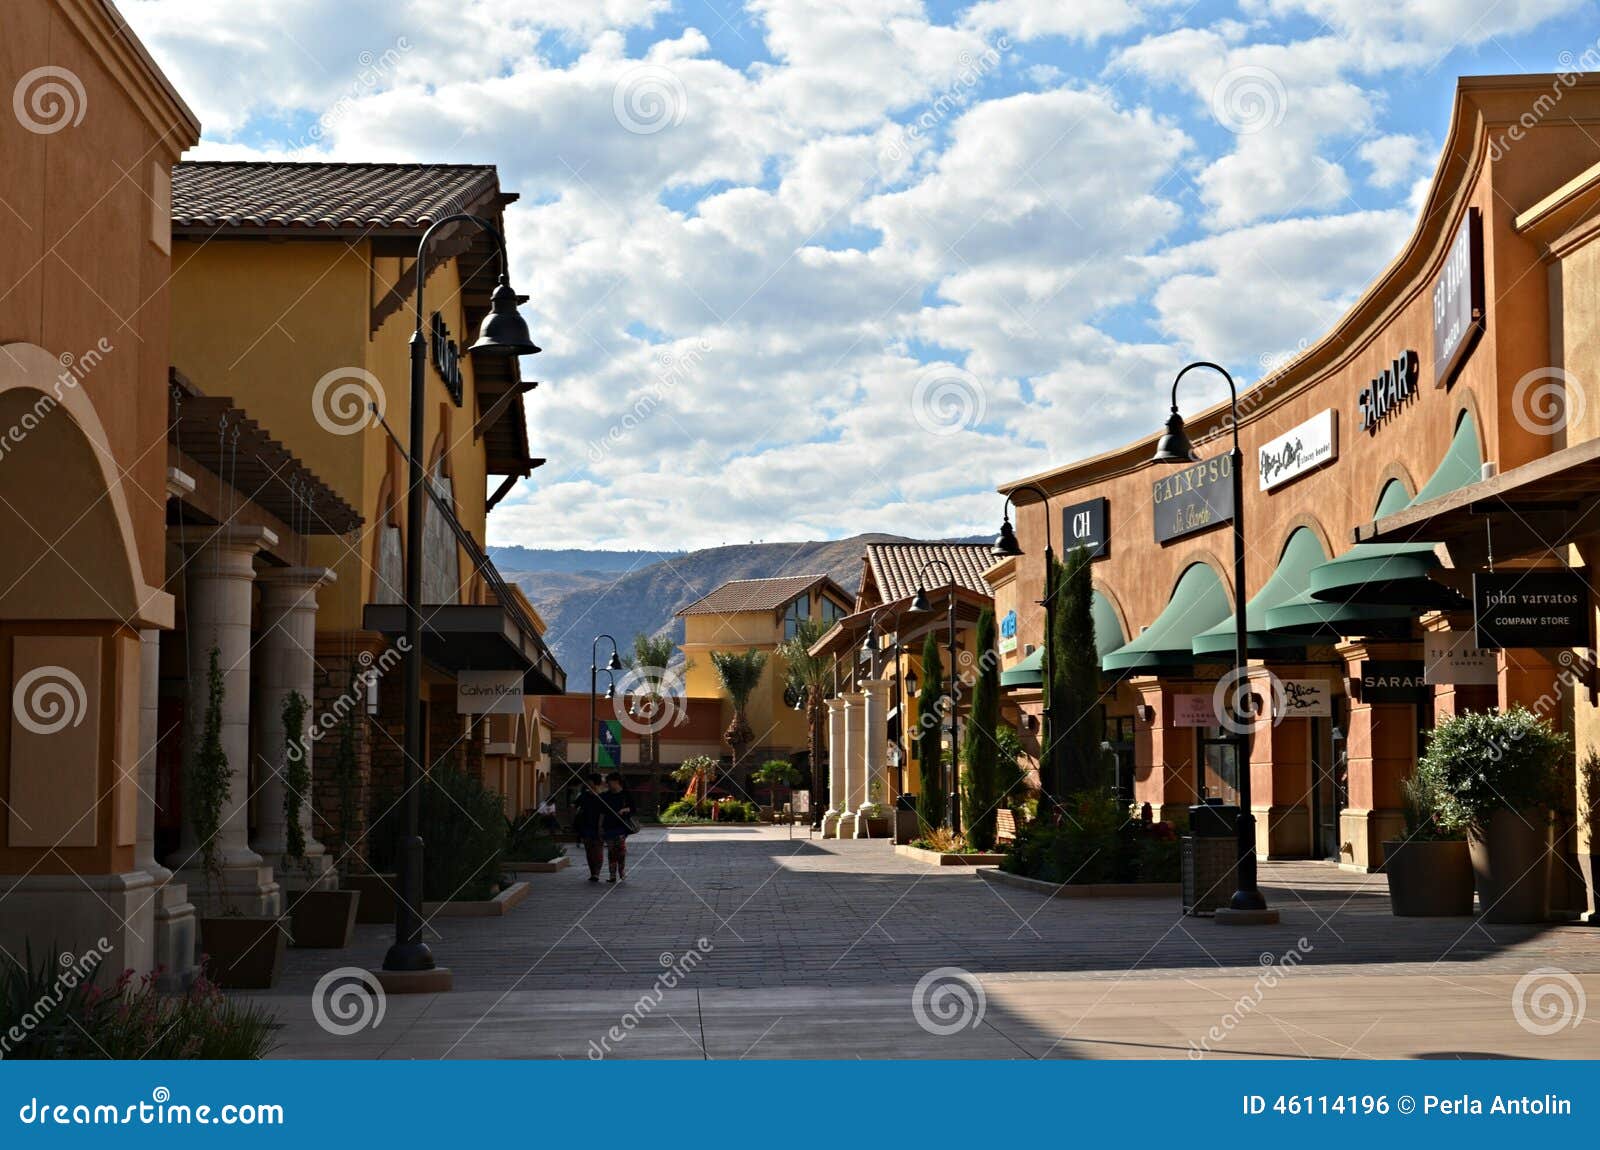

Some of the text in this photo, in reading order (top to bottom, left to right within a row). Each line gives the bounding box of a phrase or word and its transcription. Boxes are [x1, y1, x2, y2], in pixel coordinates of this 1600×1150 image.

[1359, 349, 1420, 432] SARAR
[1153, 455, 1233, 504] CALYPSO
[1072, 511, 1091, 538] CH
[1486, 590, 1578, 608] john varvatos
[1495, 617, 1570, 625] COMPANY STORE
[460, 684, 521, 696] Calvin Klein
[1364, 676, 1425, 688] SARAR
